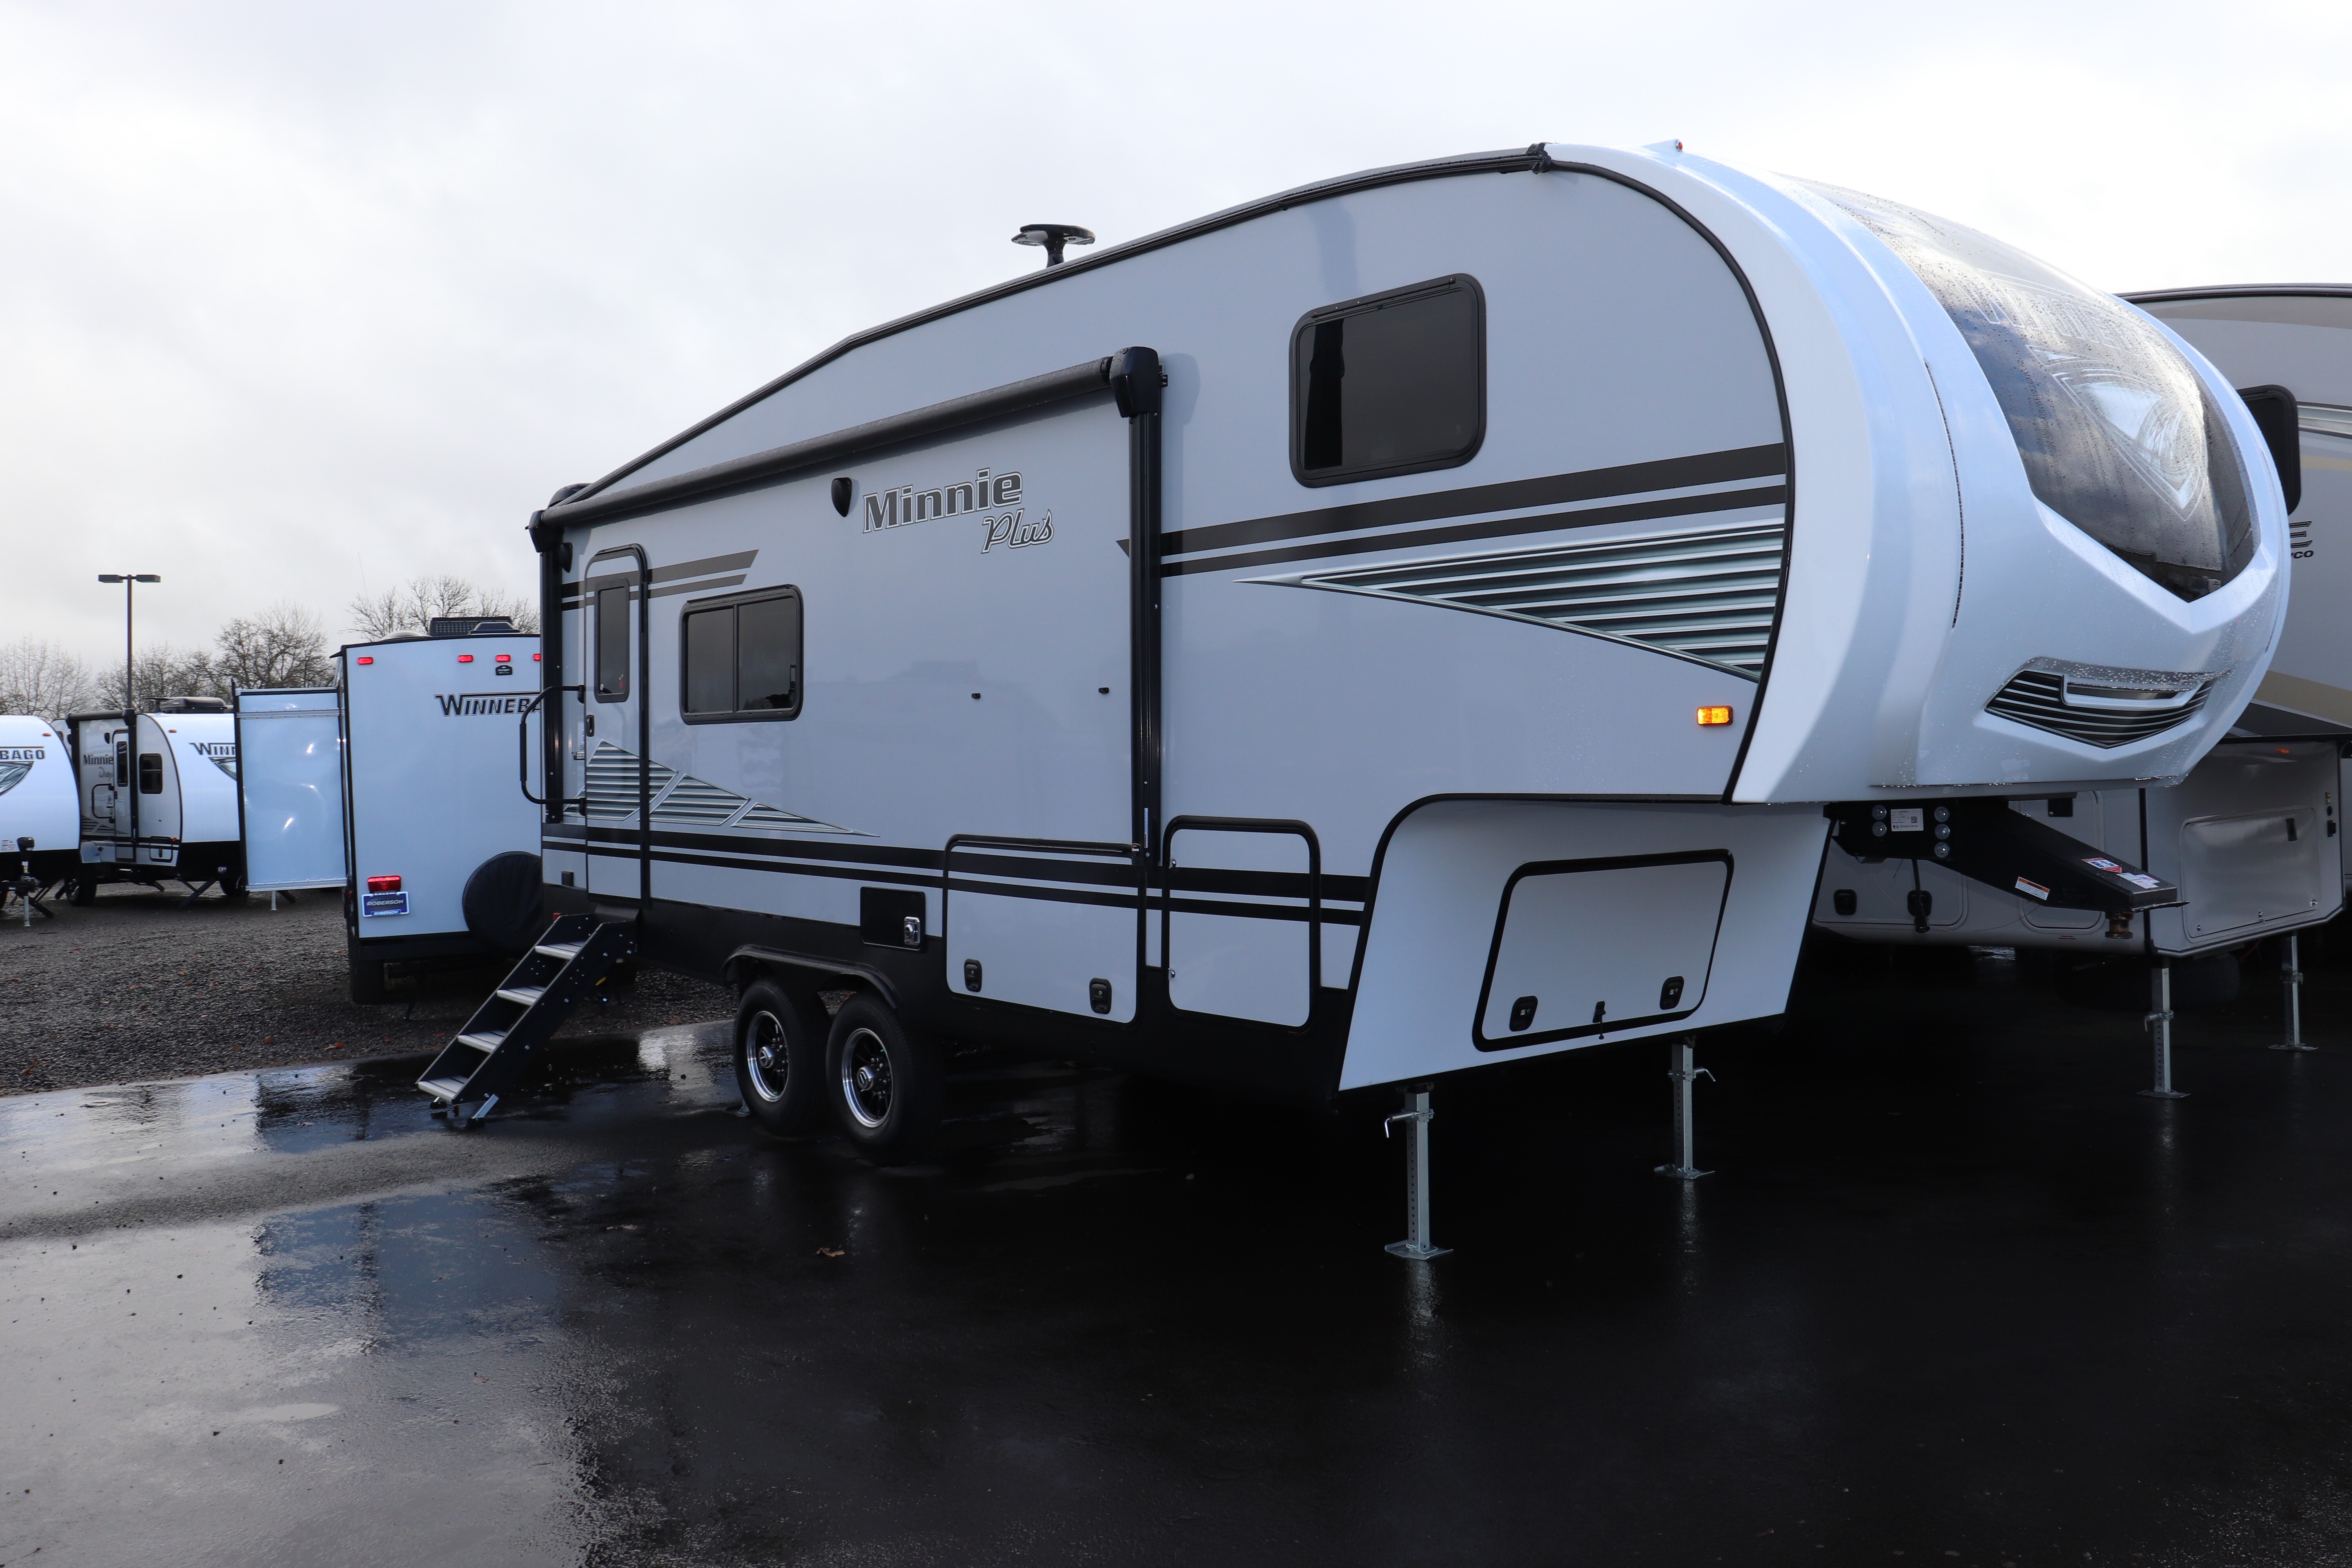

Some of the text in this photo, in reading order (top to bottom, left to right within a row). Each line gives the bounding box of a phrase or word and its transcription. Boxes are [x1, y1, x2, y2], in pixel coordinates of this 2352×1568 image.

[863, 467, 1023, 534] Minnie
[981, 508, 1054, 554] Plus
[83, 754, 113, 766] Minnie
